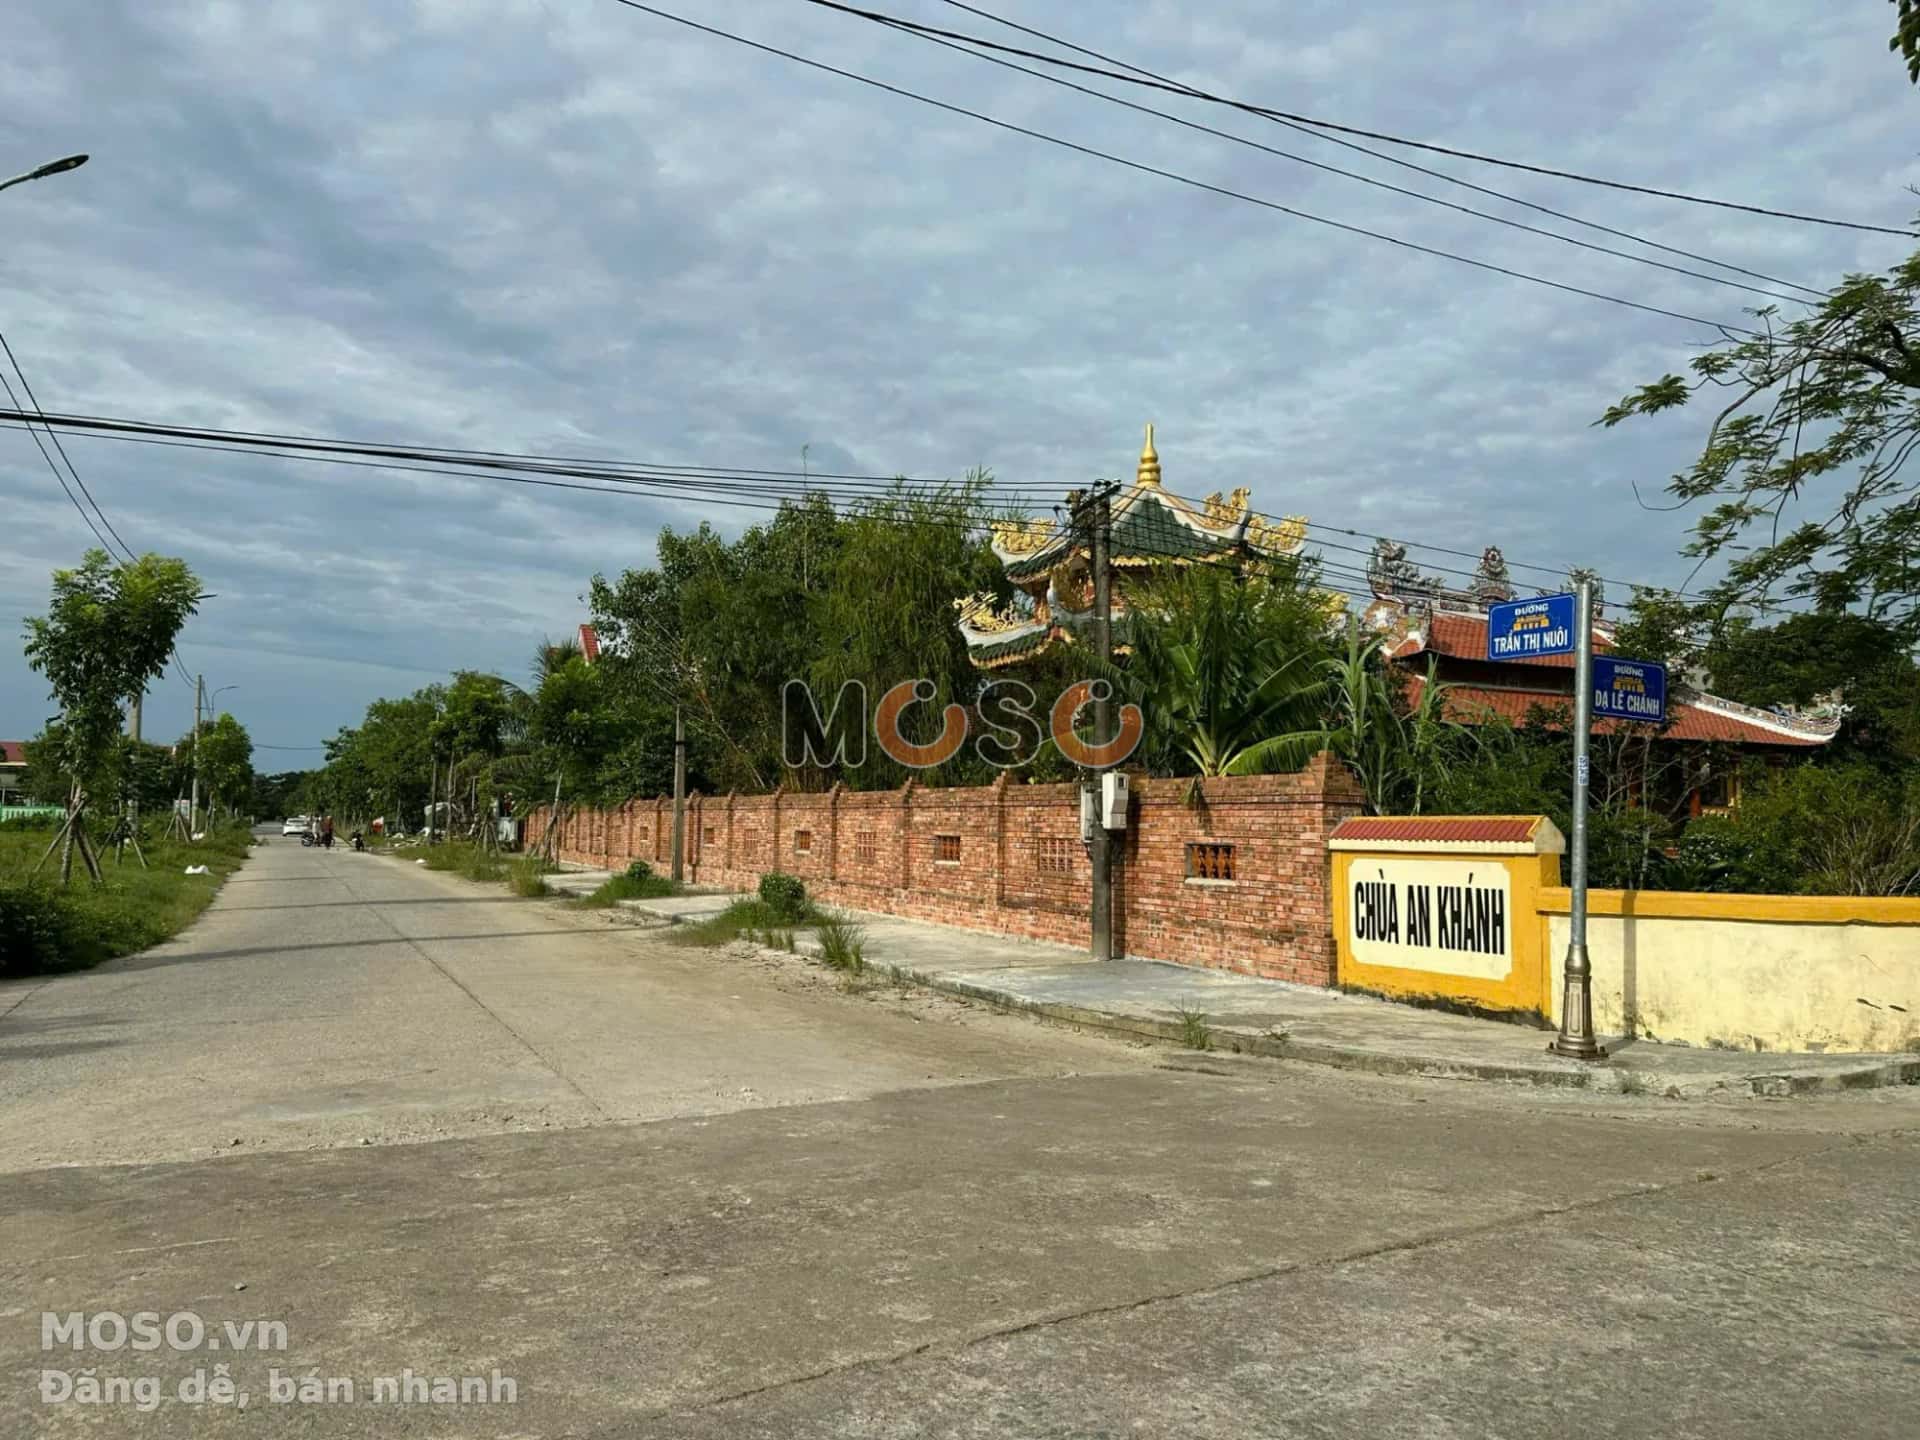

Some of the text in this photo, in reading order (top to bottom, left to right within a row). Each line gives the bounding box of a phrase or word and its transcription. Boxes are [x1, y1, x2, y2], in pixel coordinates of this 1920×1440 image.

[1523, 633, 1540, 652] THỊ
[1543, 625, 1568, 648] NUÔI
[1595, 689, 1609, 710] DẠ
[1354, 868, 1505, 955] CHÙA AN KHÁNH
